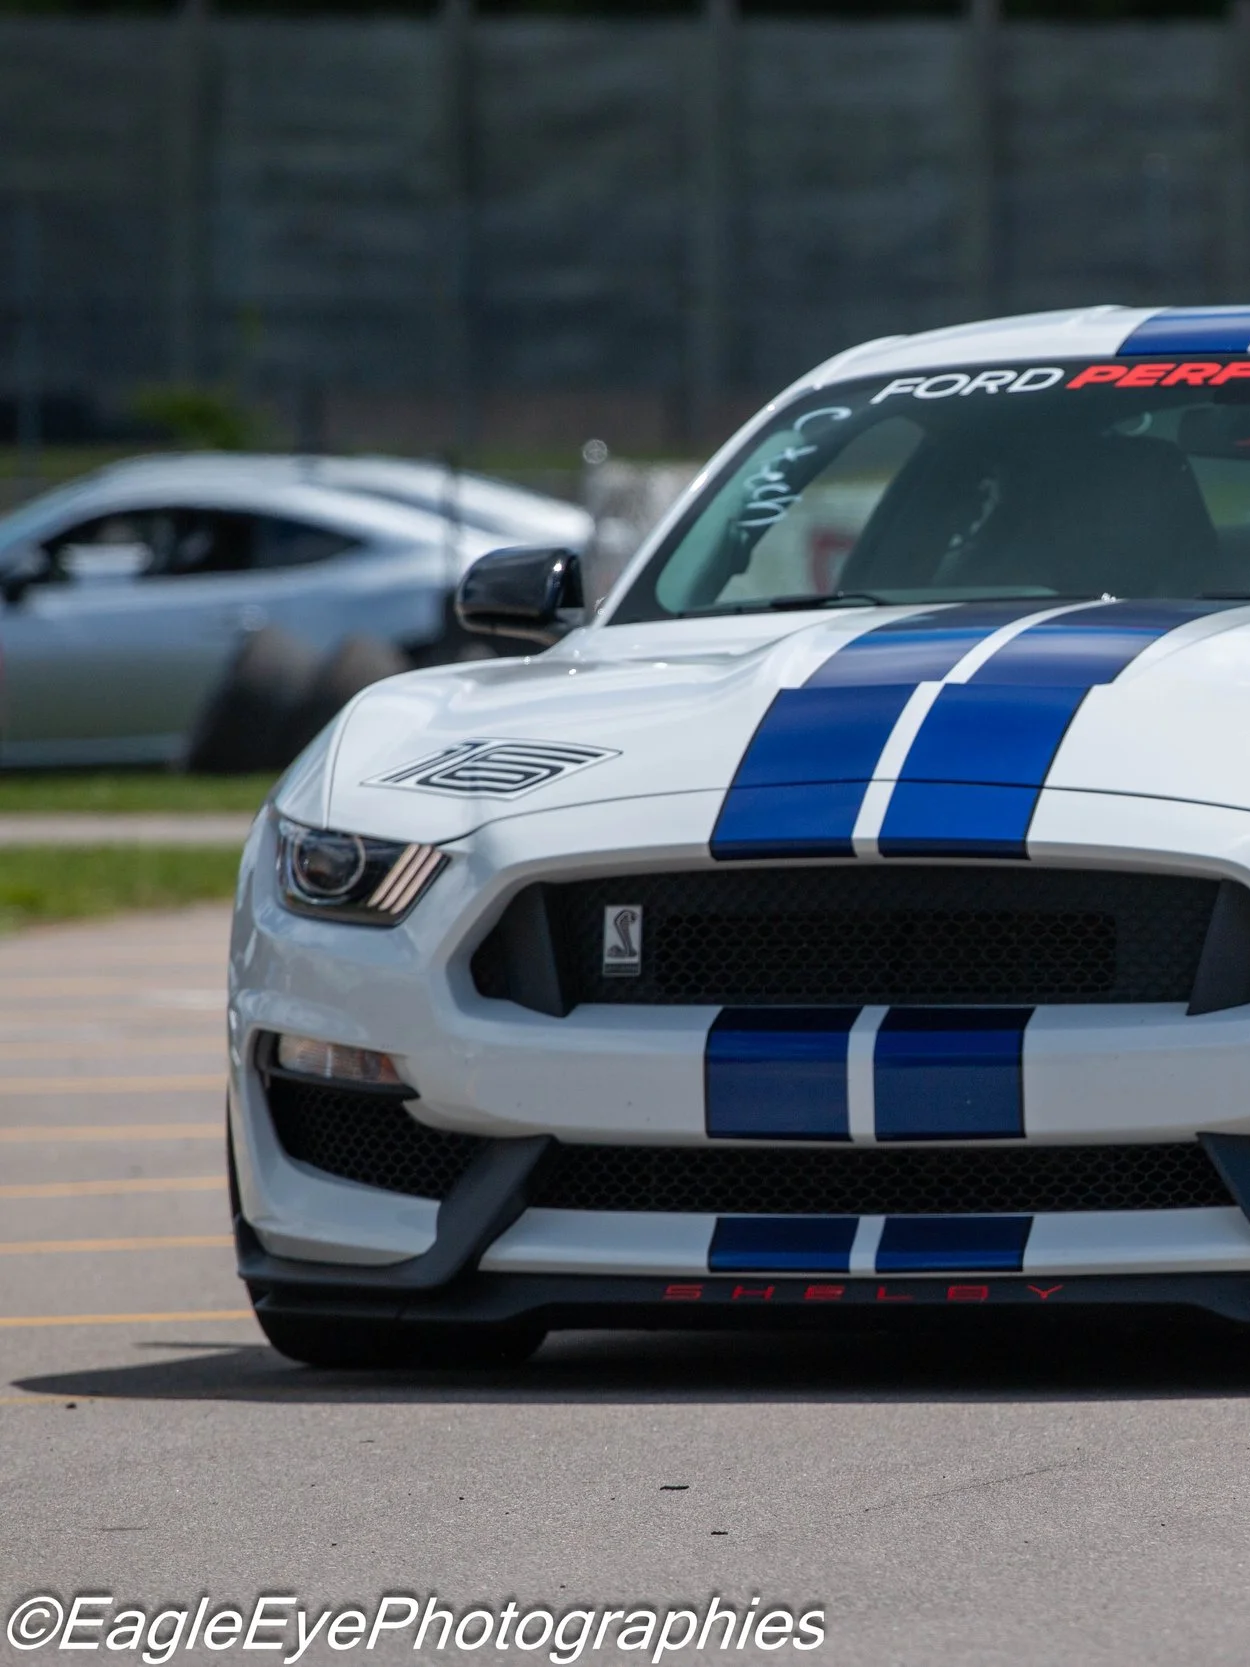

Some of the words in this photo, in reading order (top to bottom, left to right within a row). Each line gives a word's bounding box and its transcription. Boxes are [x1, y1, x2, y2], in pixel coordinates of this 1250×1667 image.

[870, 367, 1065, 404] FORD
[379, 741, 606, 793] 16
[661, 1283, 1065, 1301] SHELBY
